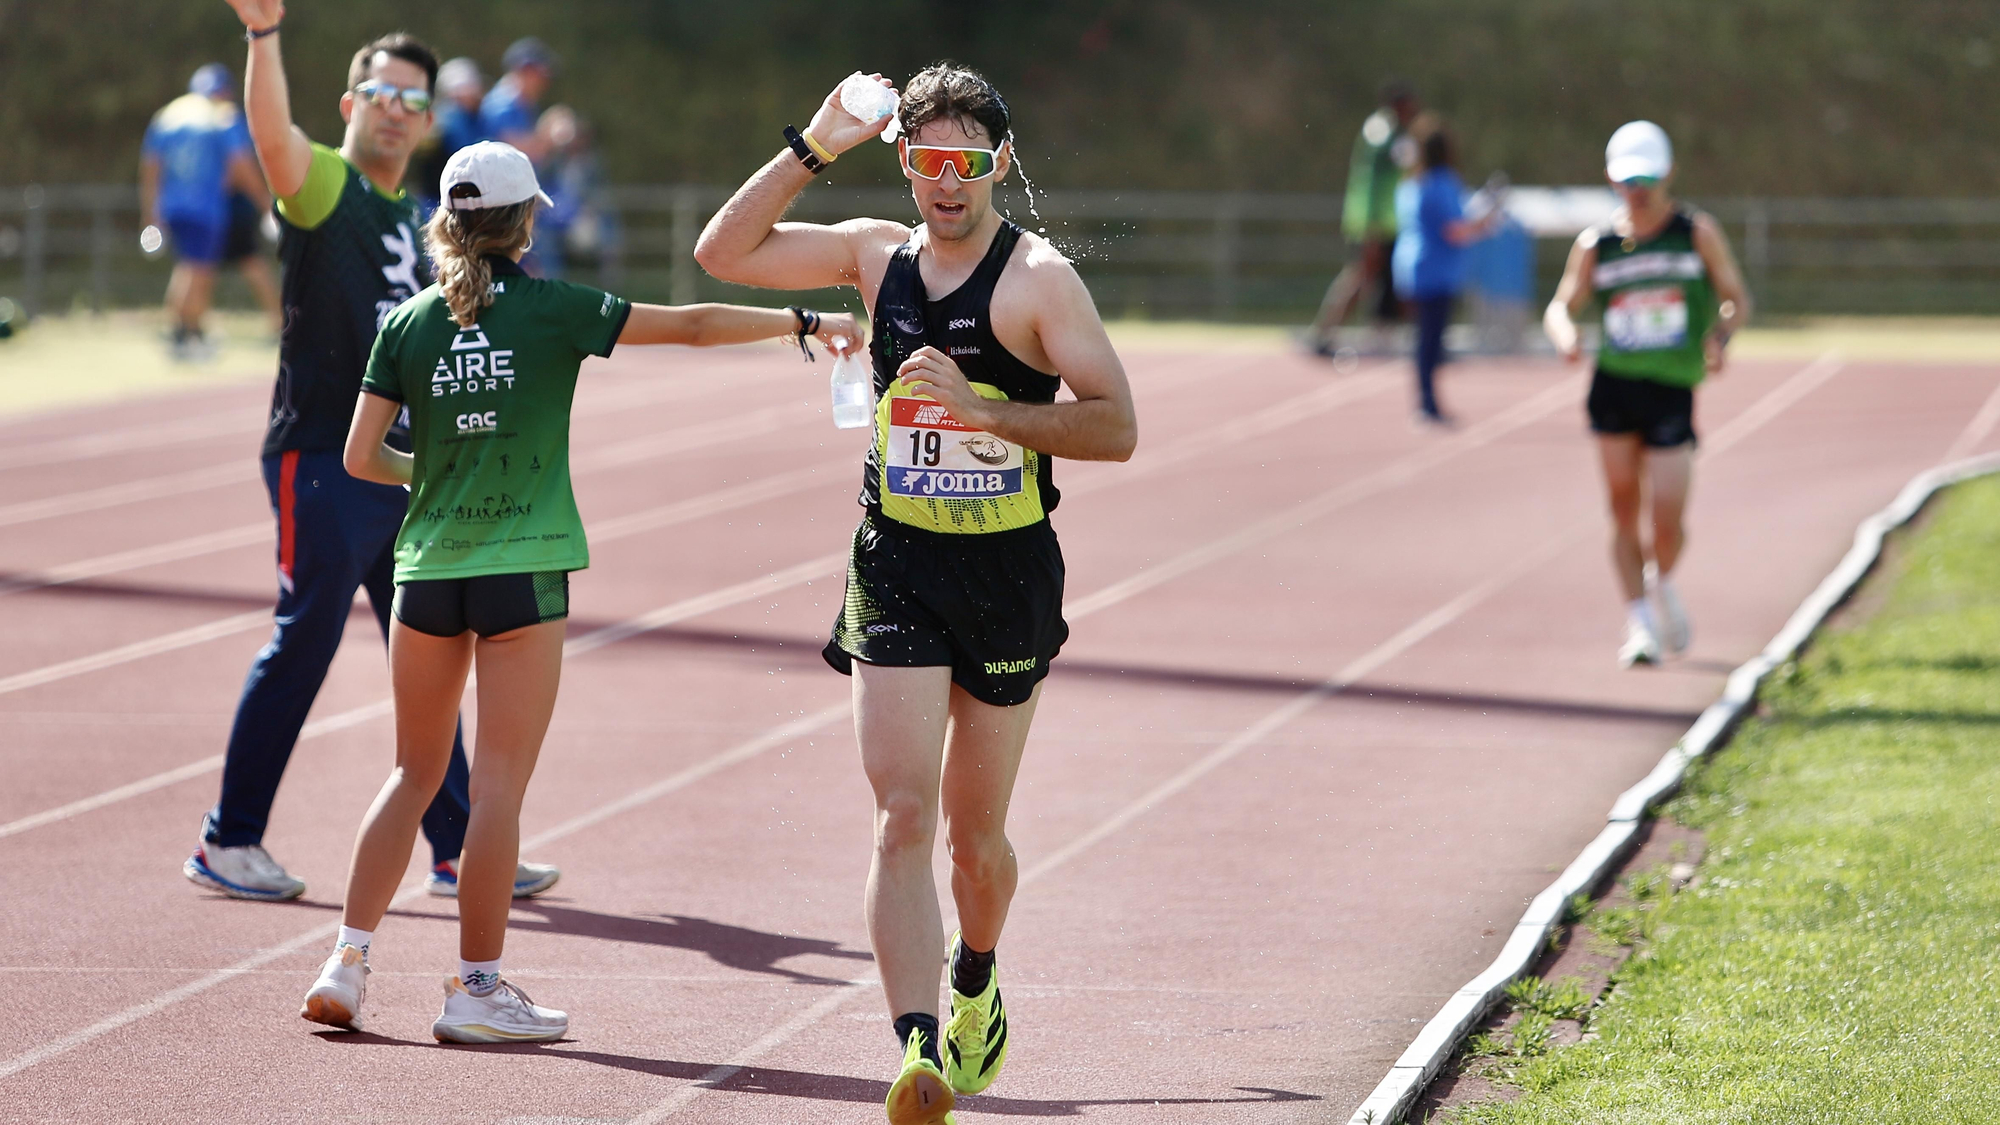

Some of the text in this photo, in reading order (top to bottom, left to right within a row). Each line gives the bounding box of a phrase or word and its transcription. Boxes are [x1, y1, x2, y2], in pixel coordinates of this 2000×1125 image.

[431, 349, 515, 383] AIRE
[431, 376, 515, 397] SPORT
[456, 410, 497, 429] CAC
[909, 429, 942, 467] 19
[984, 656, 1037, 674] DURANGO
